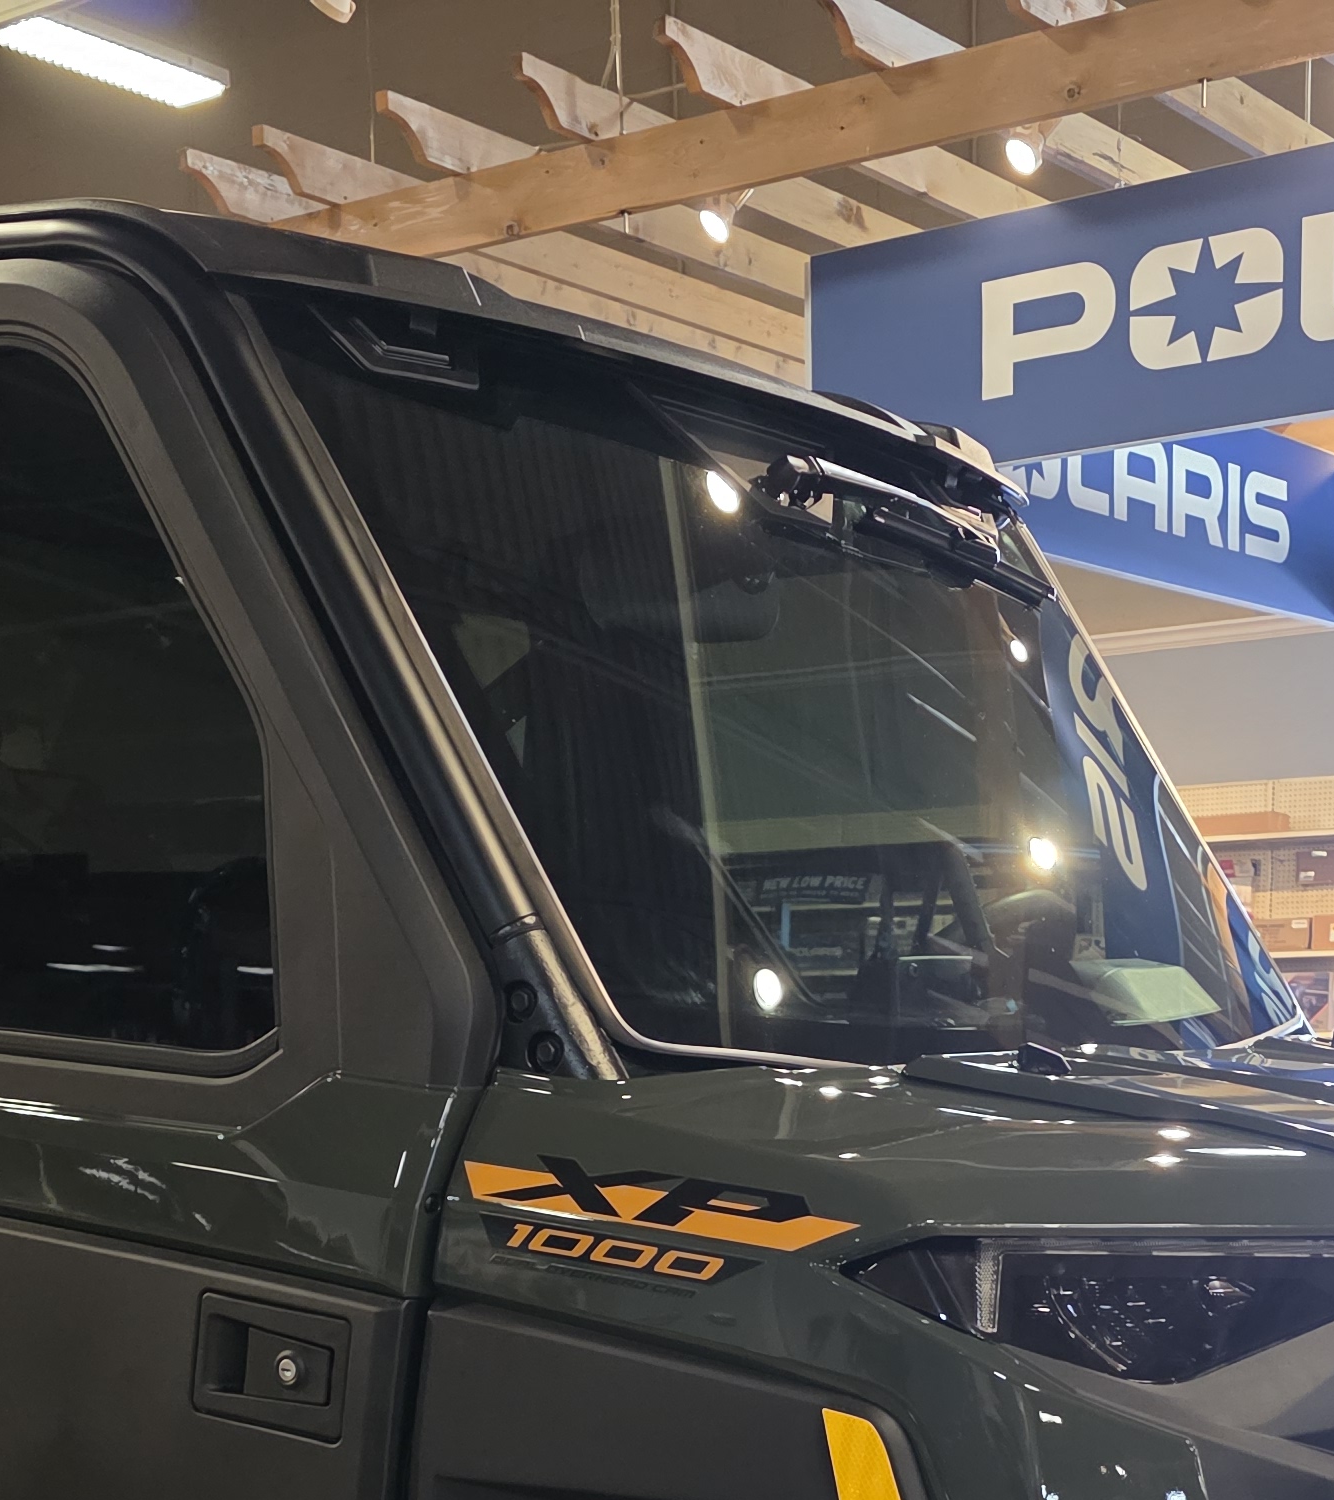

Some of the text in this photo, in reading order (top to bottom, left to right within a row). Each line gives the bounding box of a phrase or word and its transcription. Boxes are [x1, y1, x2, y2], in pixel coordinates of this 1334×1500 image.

[999, 442, 1290, 563] LARIS
[824, 875, 866, 890] PRICE
[481, 1154, 812, 1228] XP
[506, 1223, 725, 1282] 1000
